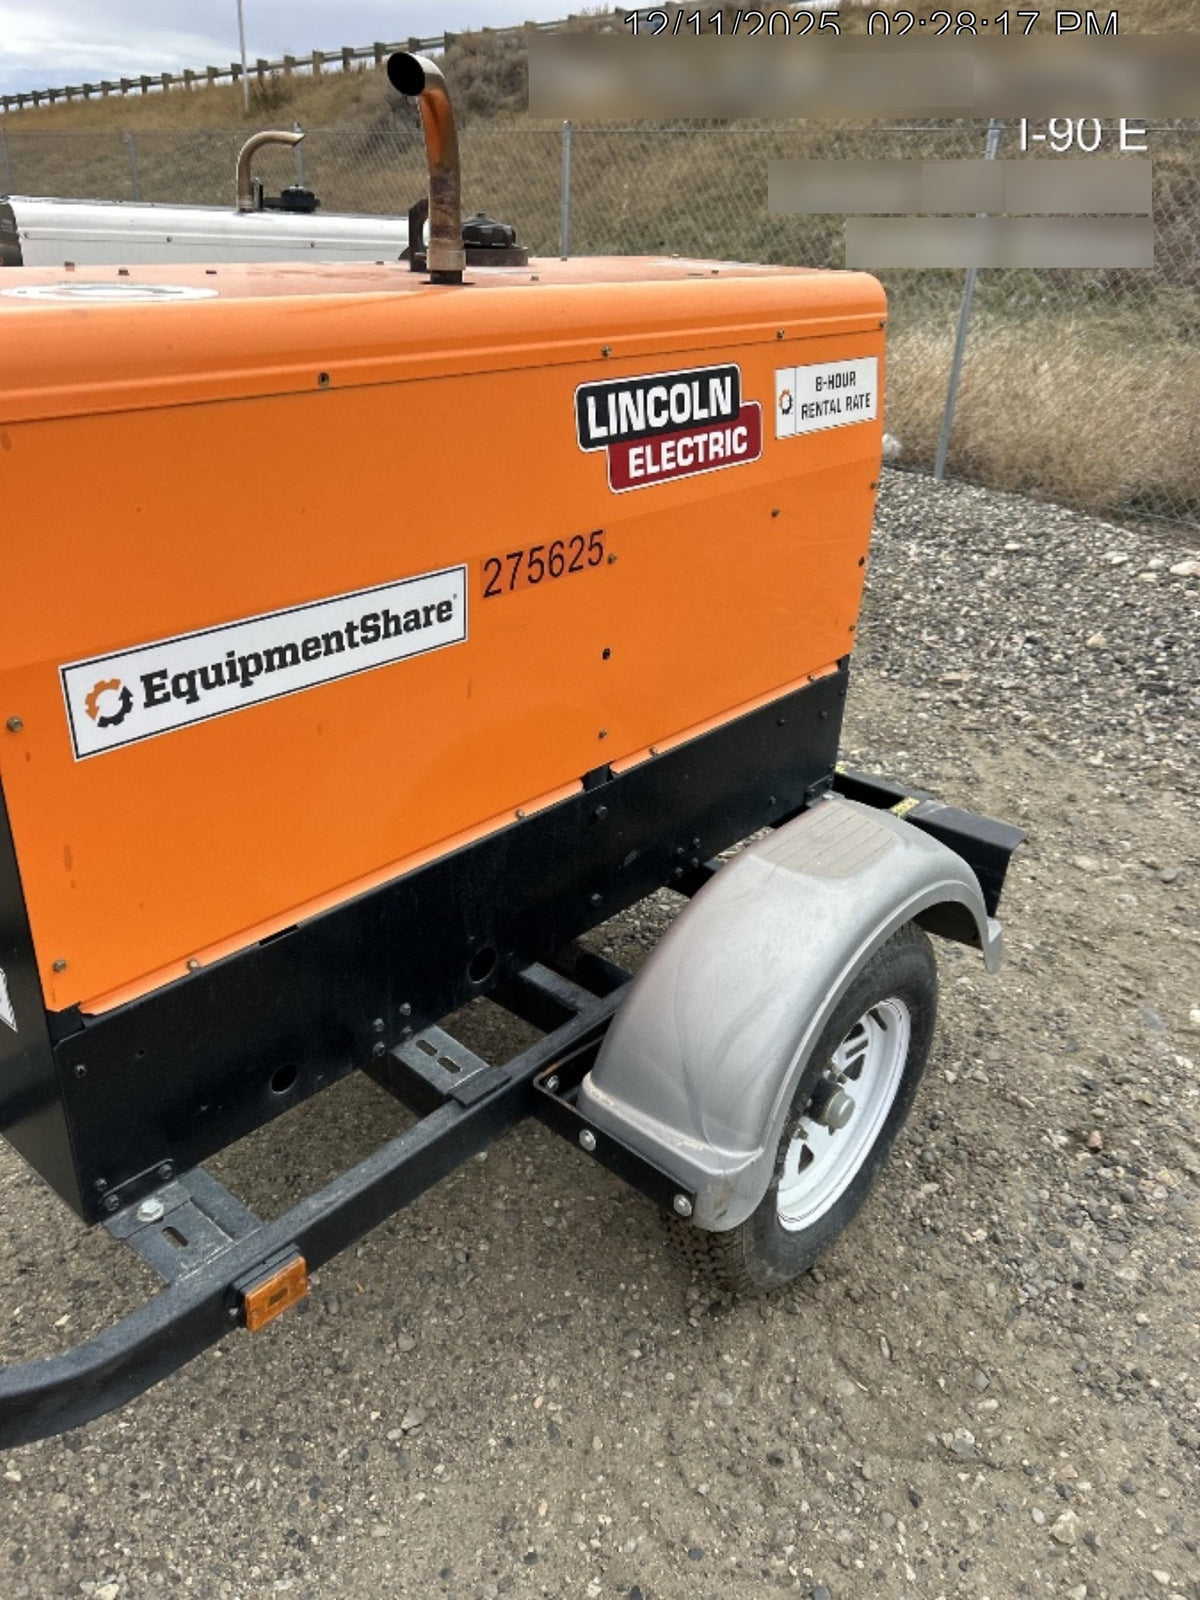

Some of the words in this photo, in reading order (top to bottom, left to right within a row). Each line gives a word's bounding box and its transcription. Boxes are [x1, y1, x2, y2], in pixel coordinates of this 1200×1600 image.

[586, 375, 732, 440] LINCOLN
[801, 397, 842, 421] RENTAL
[845, 392, 872, 412] RATE
[627, 425, 748, 479] ELECTRIC
[483, 529, 604, 598] 275625
[139, 598, 455, 709] EquipmentShare
